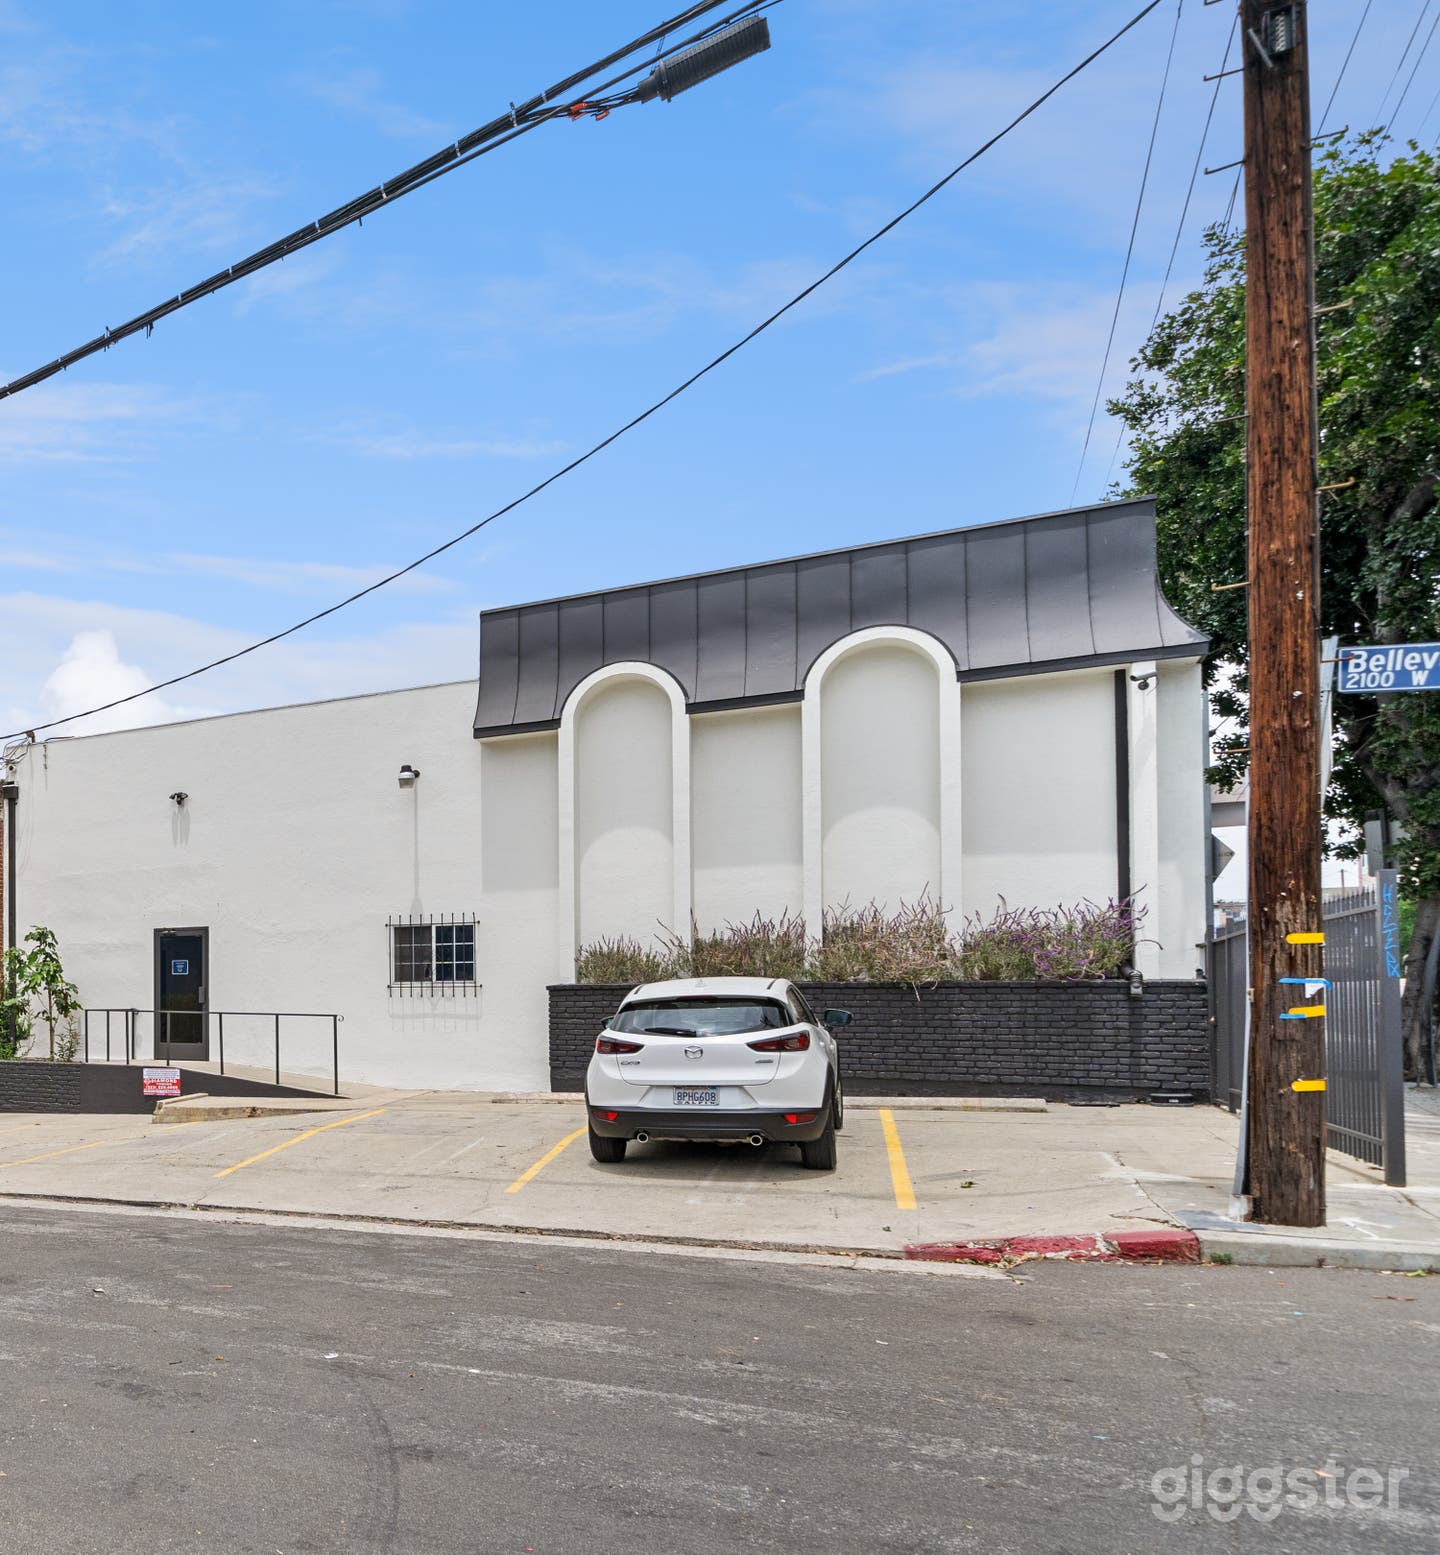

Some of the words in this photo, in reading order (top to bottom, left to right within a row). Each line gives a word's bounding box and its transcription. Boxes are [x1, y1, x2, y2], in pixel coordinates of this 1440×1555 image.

[1348, 648, 1440, 673] Bellev
[1345, 671, 1394, 688] 2100
[1411, 670, 1429, 686] W
[676, 1091, 717, 1102] 8PHG608
